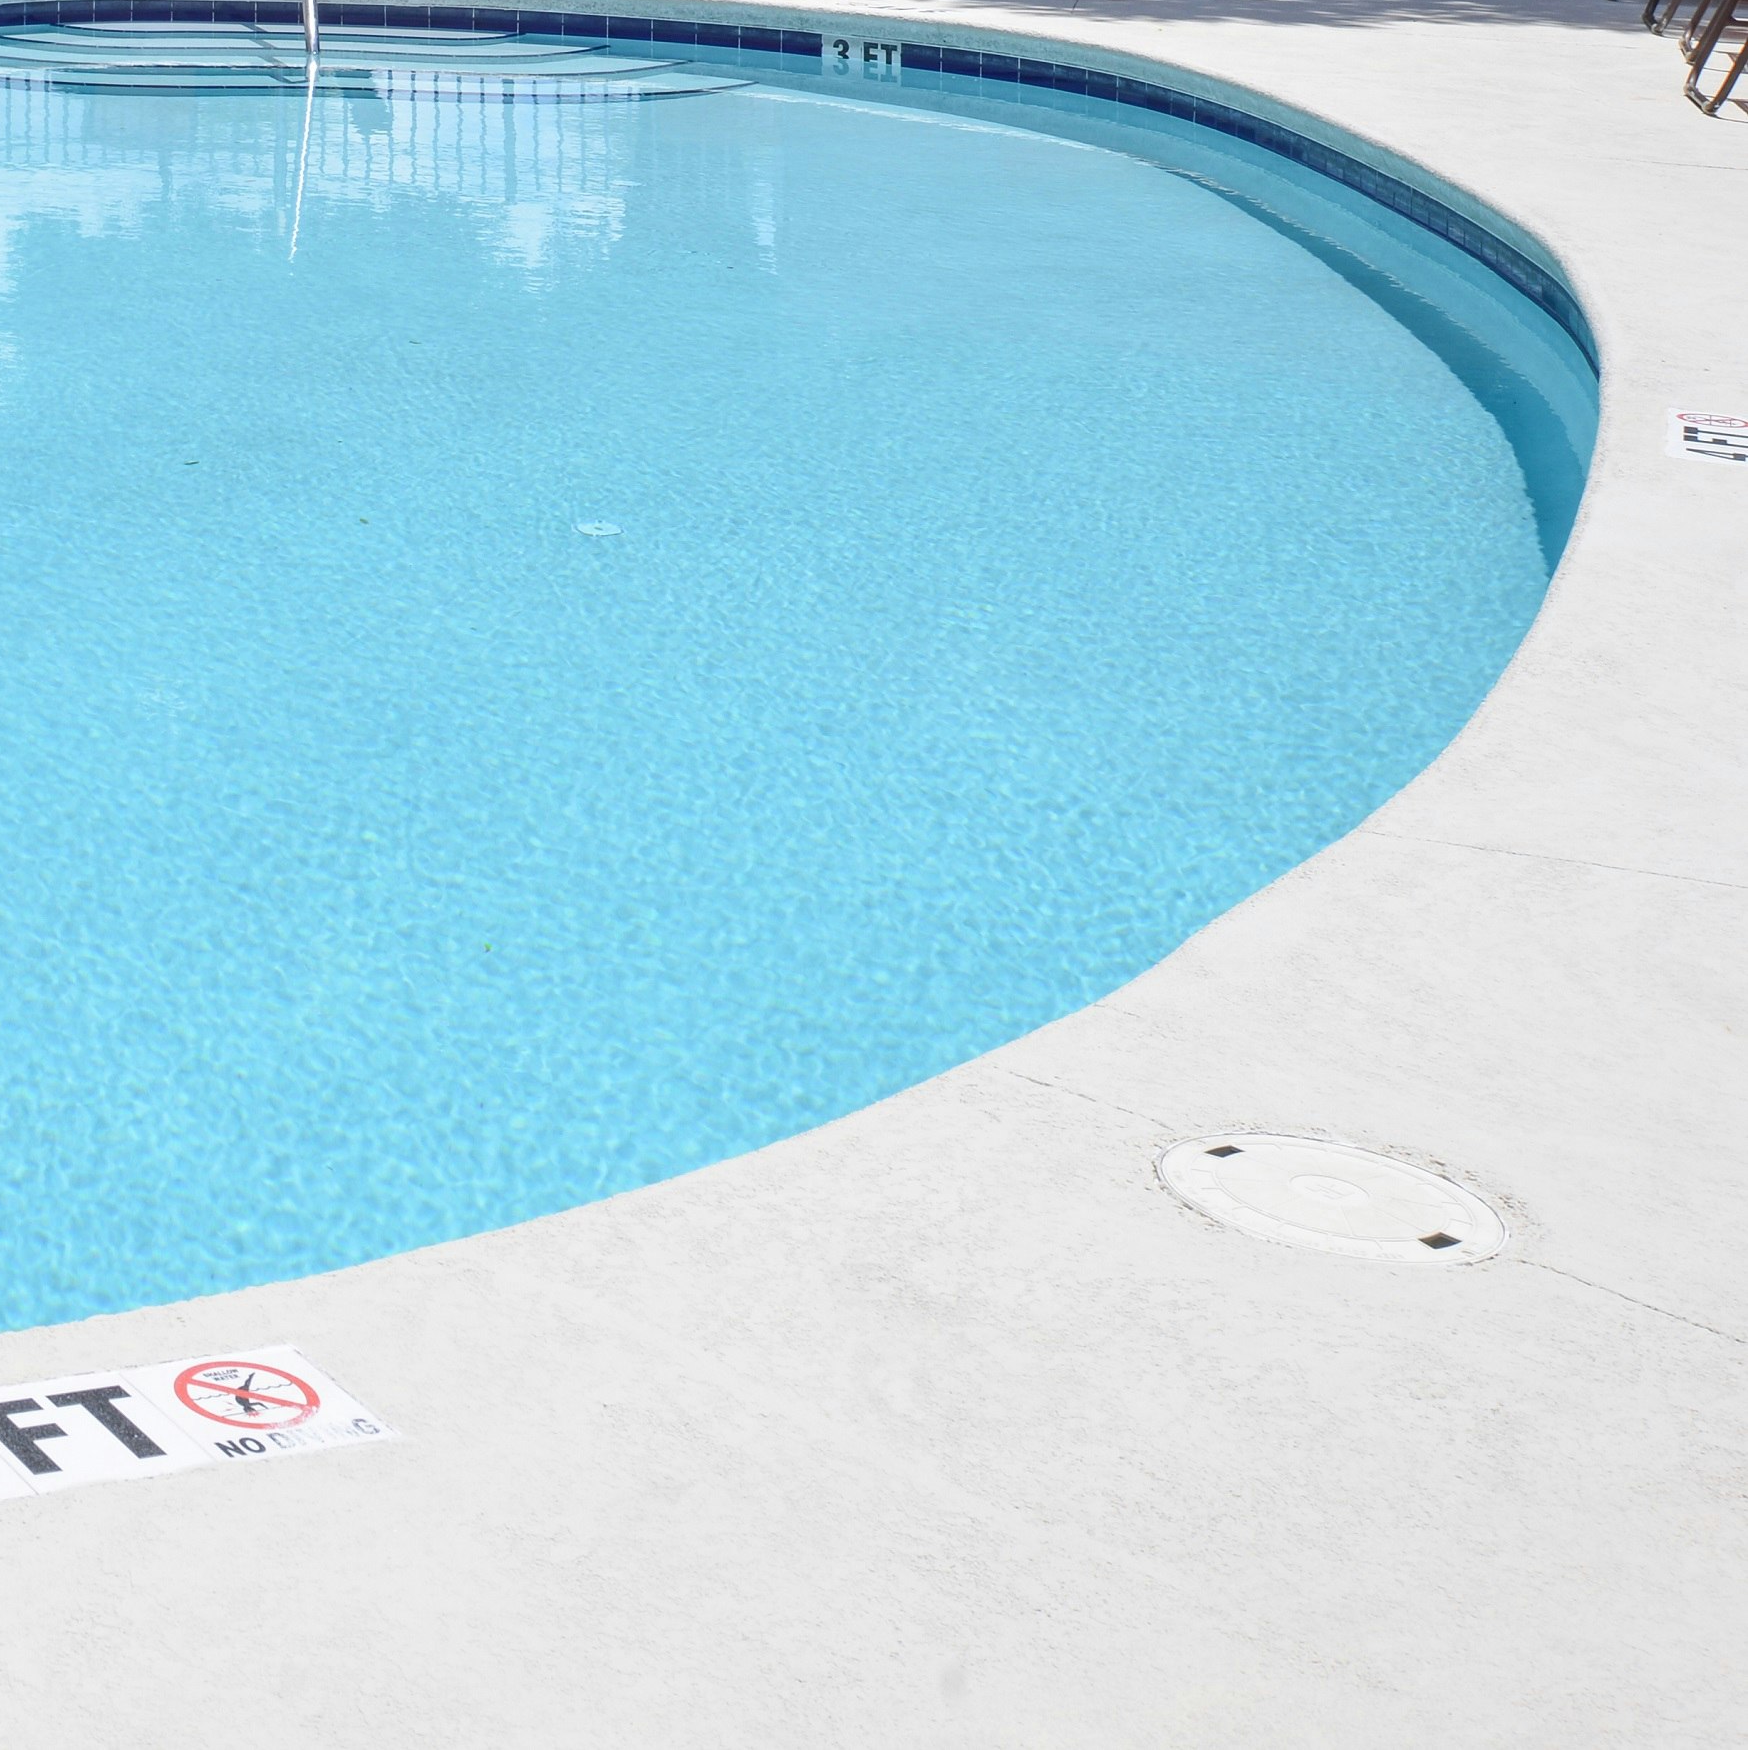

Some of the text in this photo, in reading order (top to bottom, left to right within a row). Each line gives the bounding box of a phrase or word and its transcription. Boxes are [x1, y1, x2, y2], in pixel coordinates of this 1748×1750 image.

[833, 39, 898, 65] 3 FT
[214, 1437, 266, 1457] NO
